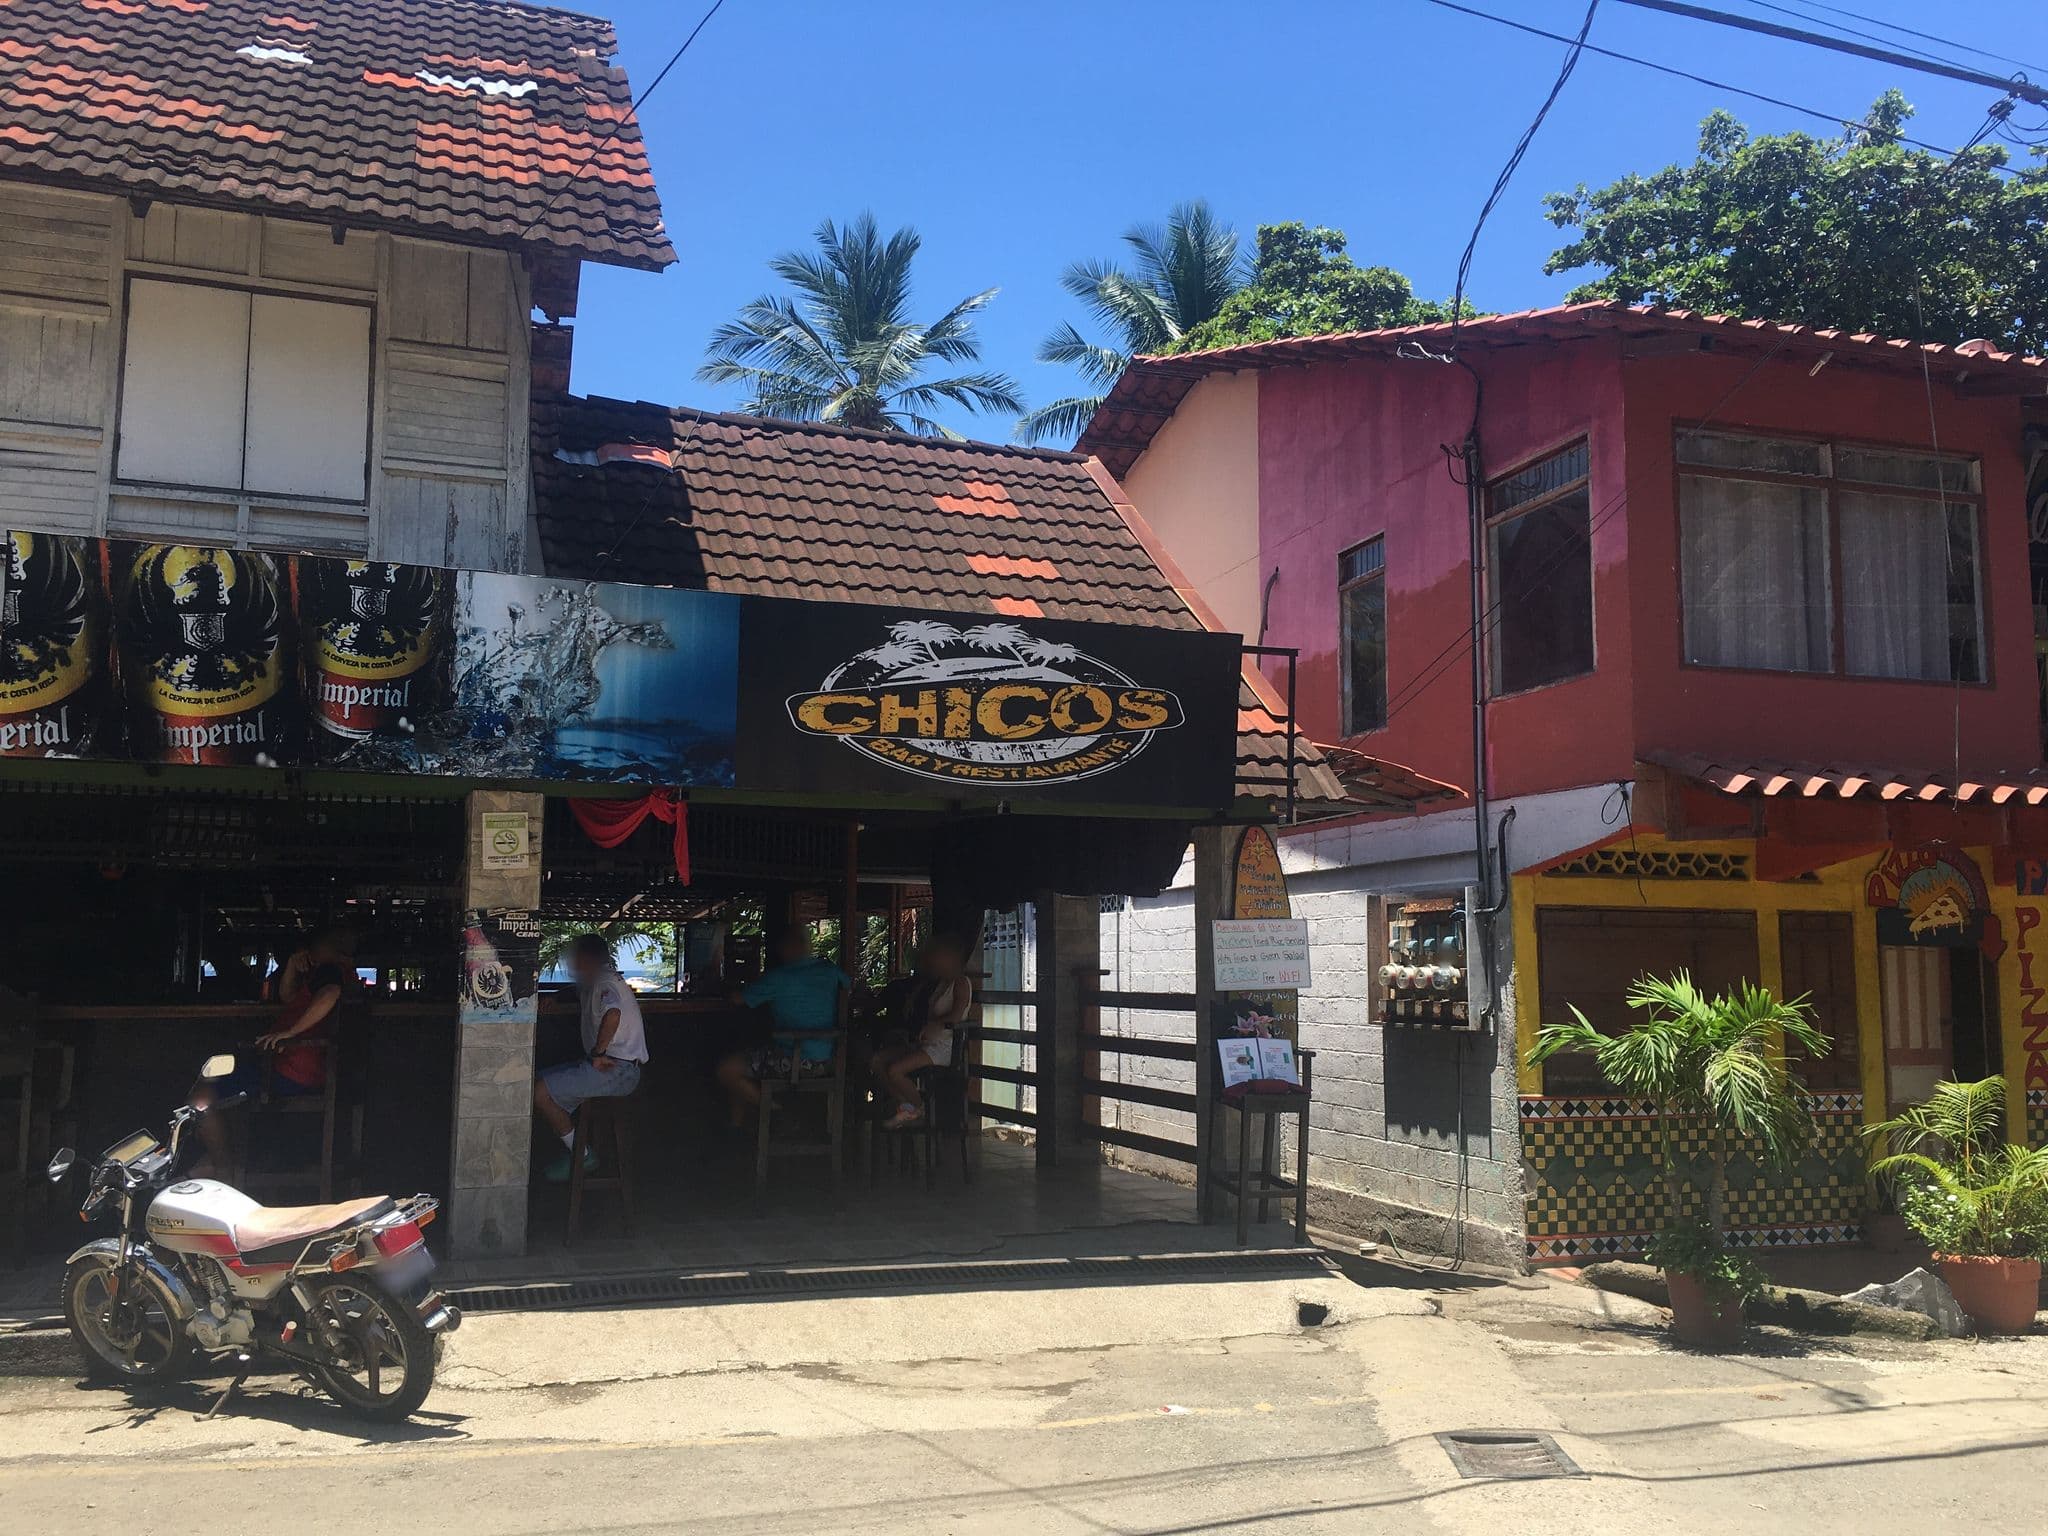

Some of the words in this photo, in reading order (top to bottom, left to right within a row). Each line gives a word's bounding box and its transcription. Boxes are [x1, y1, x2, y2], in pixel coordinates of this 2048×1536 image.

[330, 655, 360, 668] CERVEZA
[360, 661, 370, 669] DE
[371, 660, 392, 669] COSTA
[392, 655, 408, 667] RICA
[10, 686, 38, 699] COSTA
[39, 675, 59, 691] RICA
[158, 688, 168, 698] LA
[168, 693, 203, 705] CERVEZA
[204, 697, 216, 705] DE
[216, 694, 240, 704] COSTA
[240, 685, 257, 698] RICA
[317, 671, 412, 720] Imperial
[797, 684, 1169, 739] CHICOS
[158, 710, 265, 764] Imperial
[867, 737, 930, 766] BAR
[933, 758, 951, 772] Y
[951, 737, 1133, 778] RESTAURANTE
[2015, 906, 2048, 1086] PIZZA
